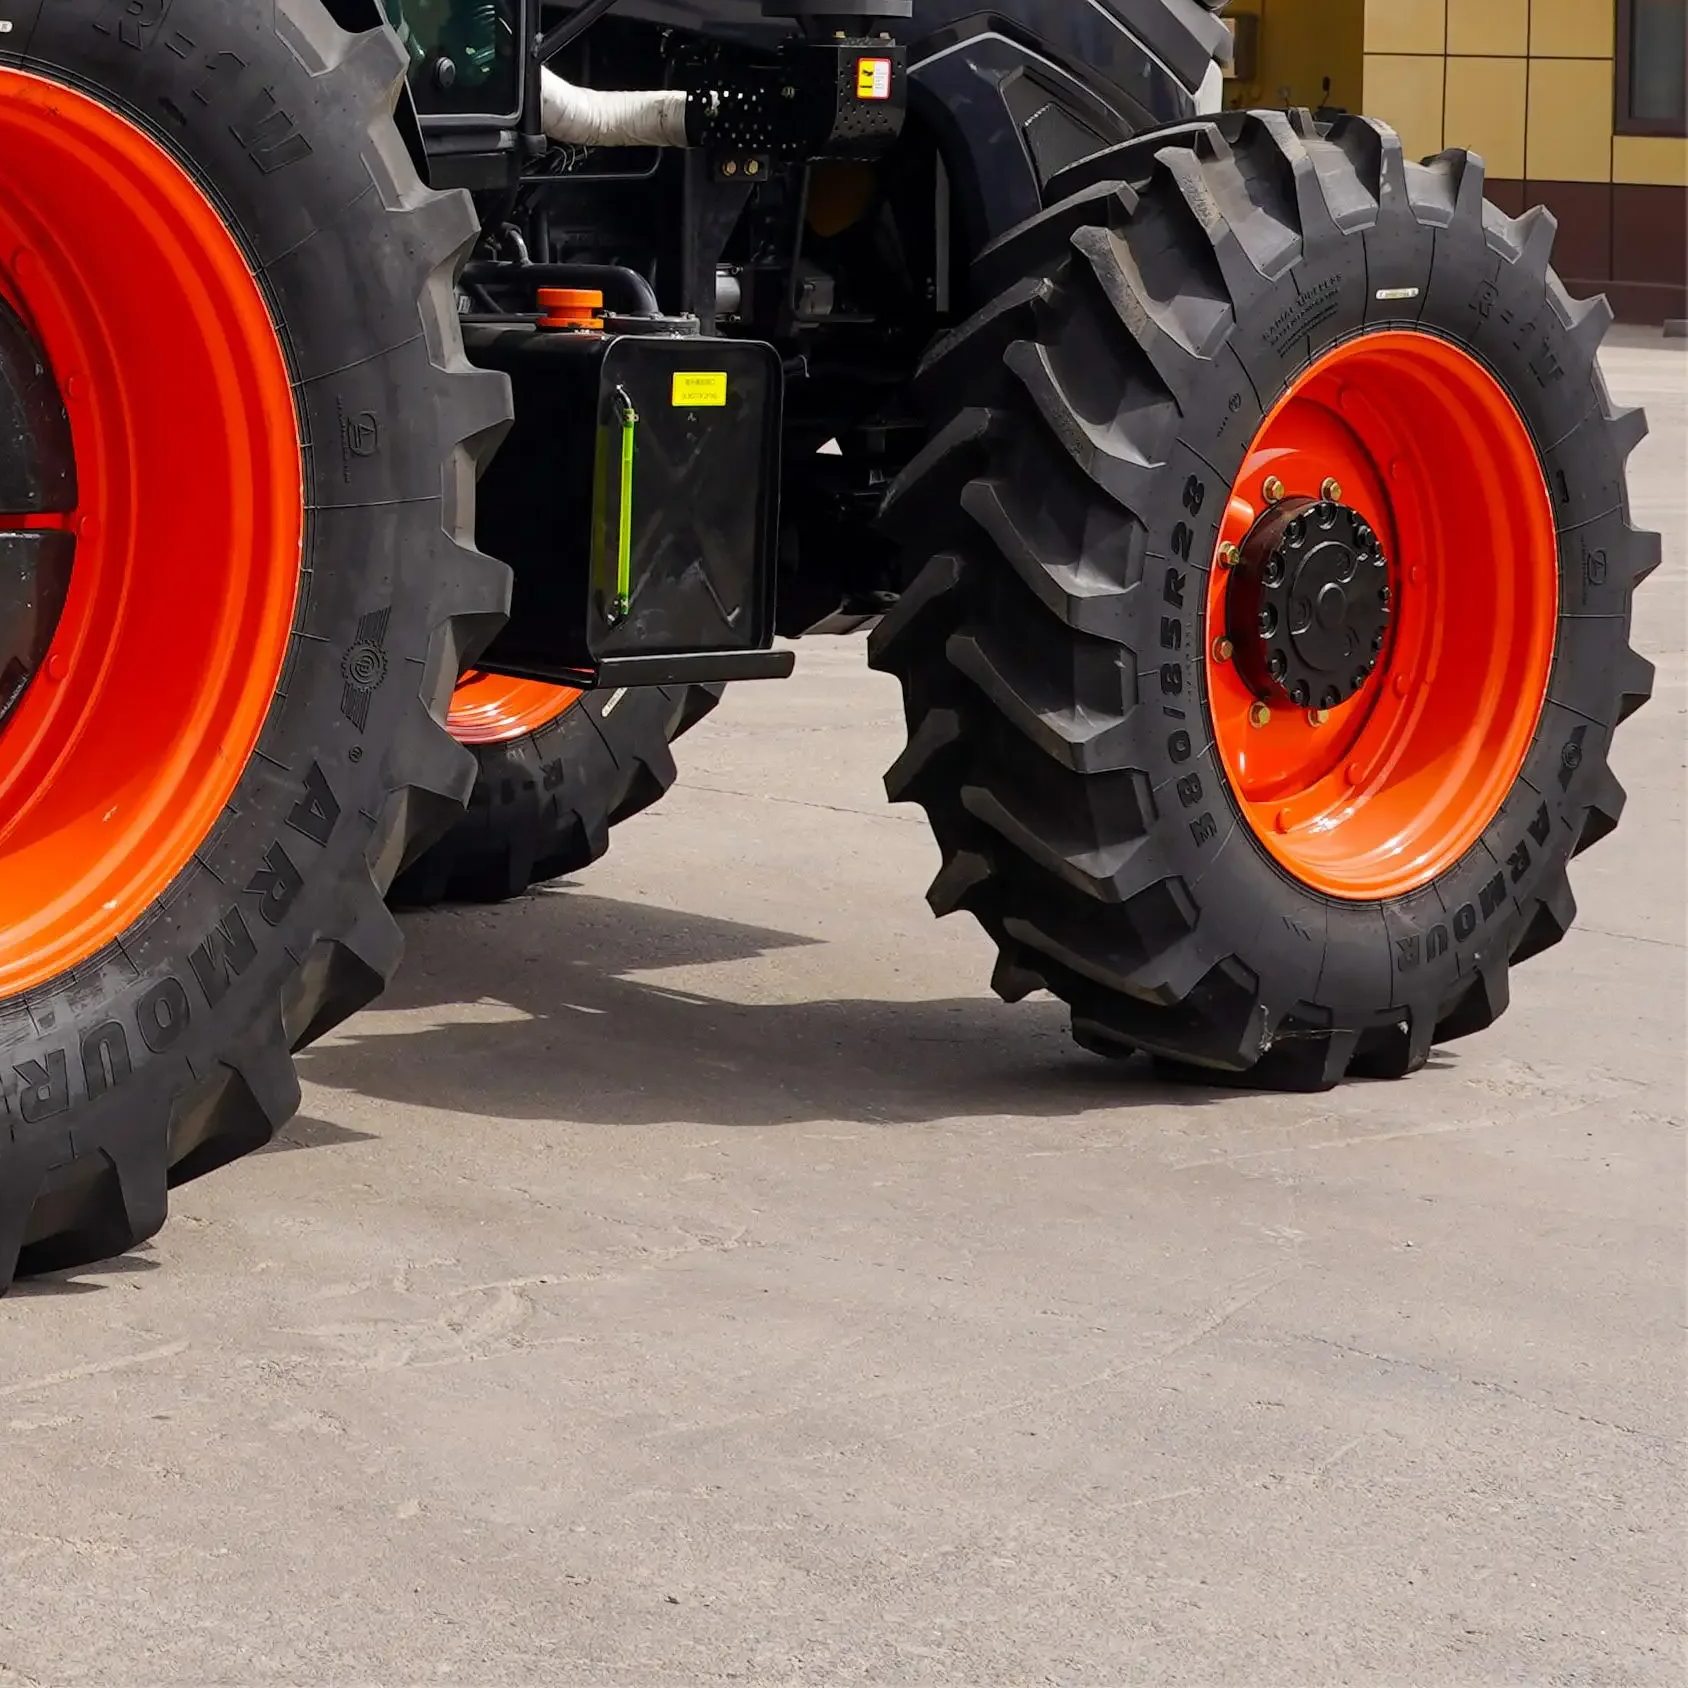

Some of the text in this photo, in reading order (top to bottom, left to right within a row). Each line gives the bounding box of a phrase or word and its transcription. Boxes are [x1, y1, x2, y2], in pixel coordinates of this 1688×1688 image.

[1160, 473, 1217, 847] 380/85R28
[13, 758, 341, 1123] ARMOUR
[1396, 800, 1550, 972] ARMOUR
